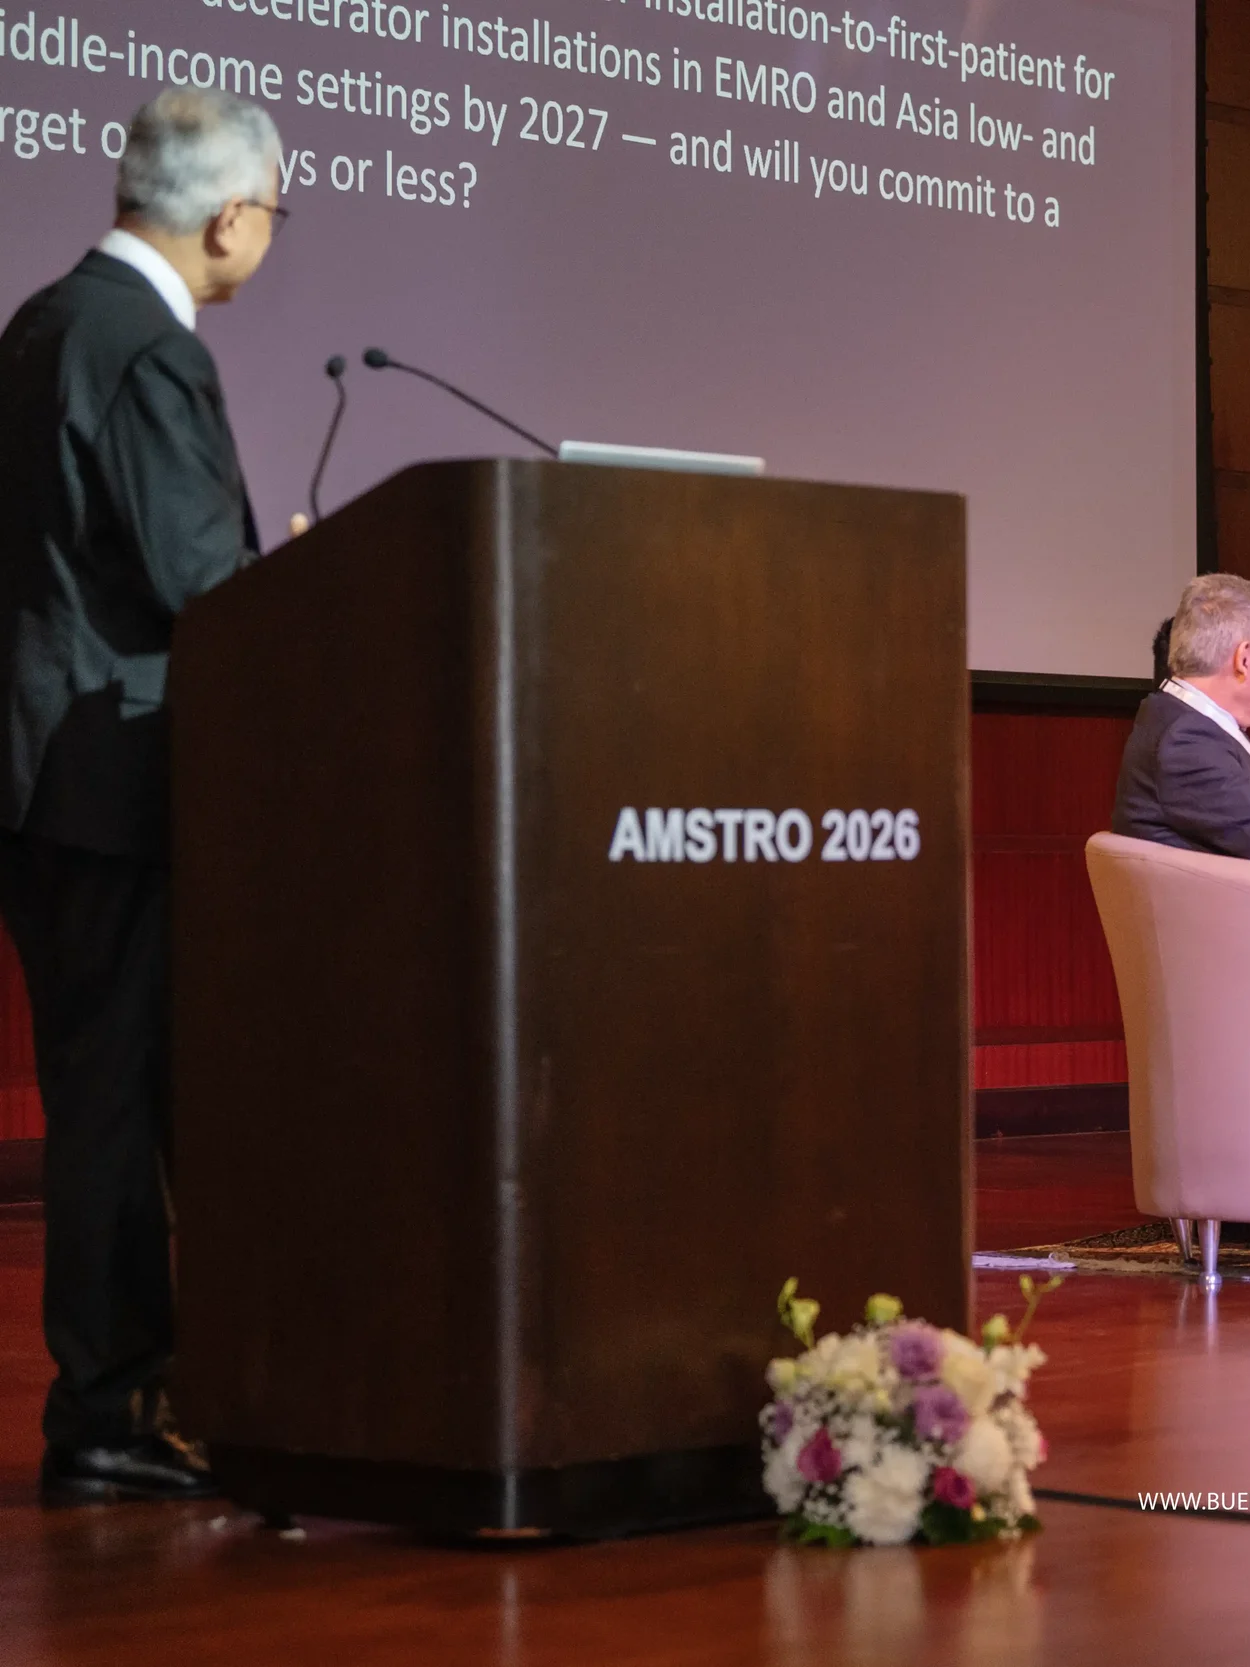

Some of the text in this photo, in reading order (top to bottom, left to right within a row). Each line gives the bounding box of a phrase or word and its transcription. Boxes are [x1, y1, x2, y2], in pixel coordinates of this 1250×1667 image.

[442, 3, 661, 87] installations
[673, 47, 702, 93] in
[715, 55, 817, 114] EMRO
[827, 86, 886, 127] and
[895, 92, 958, 141] Asia
[970, 102, 1034, 151] low-
[1043, 126, 1095, 166] and
[645, 0, 1116, 101] stallation-to-first-patient for
[101, 121, 131, 160] o
[330, 155, 373, 193] or
[386, 149, 477, 209] less?
[296, 69, 451, 136] settings
[464, 84, 508, 147] by
[519, 96, 609, 152] 2027
[669, 129, 732, 174] and
[743, 140, 799, 184] will
[810, 156, 868, 199] you
[878, 168, 996, 218] commit
[1003, 183, 1035, 223] to
[1044, 196, 1060, 228] a
[609, 807, 921, 862] AMSTRO 2026
